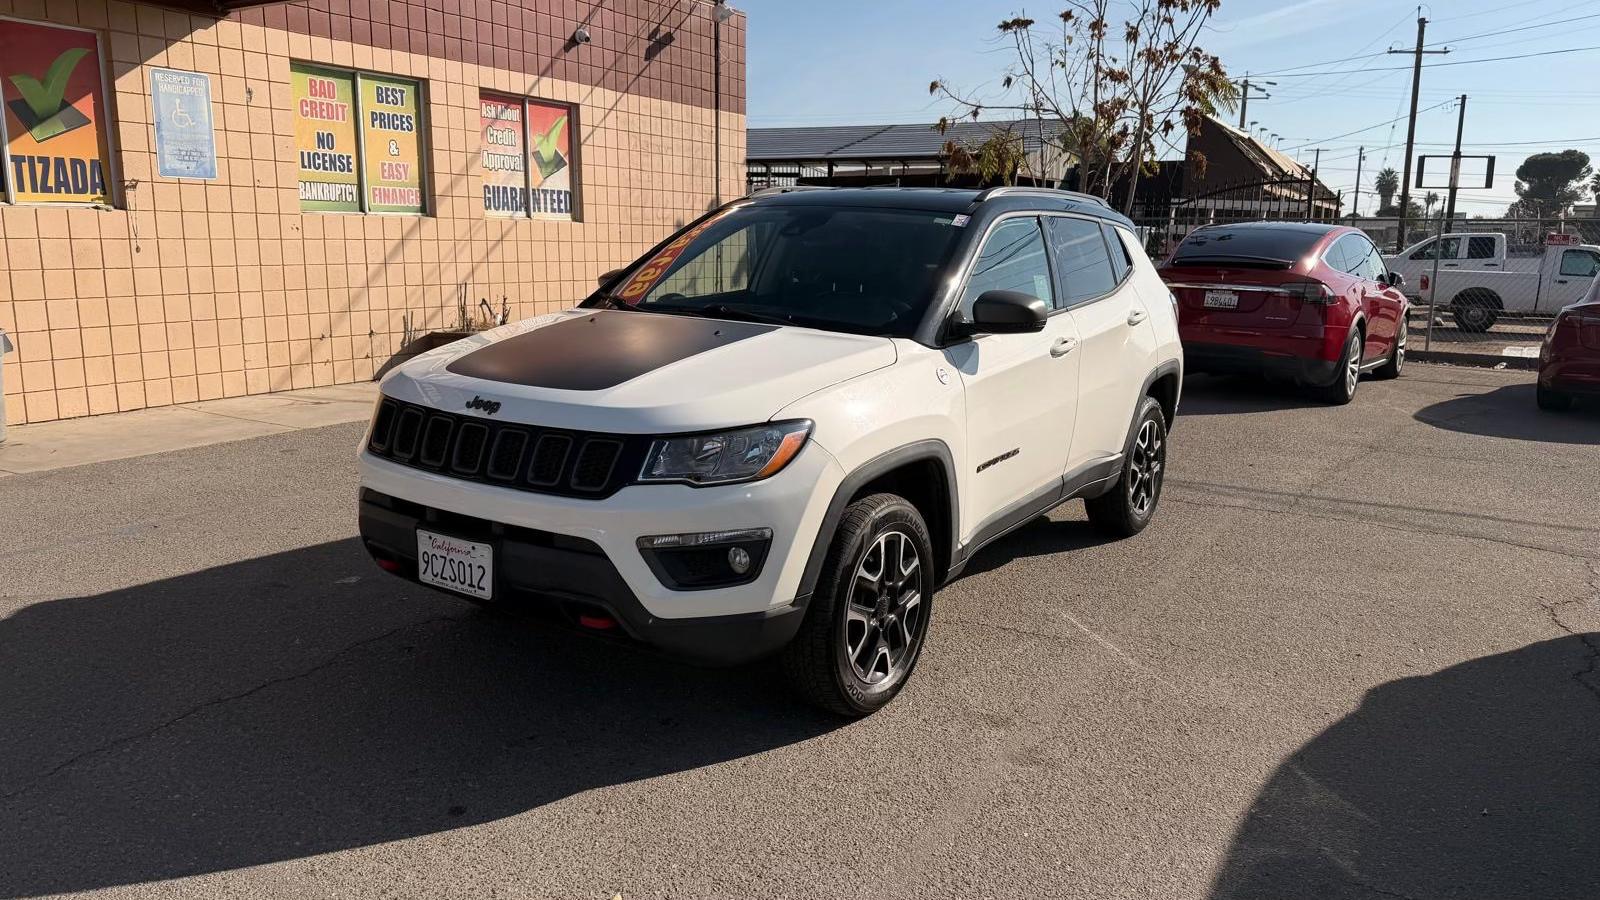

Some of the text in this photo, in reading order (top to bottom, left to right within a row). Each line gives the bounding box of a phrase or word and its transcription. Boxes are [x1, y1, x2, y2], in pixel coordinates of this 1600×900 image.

[154, 72, 206, 88] RESERVED FOR
[159, 83, 206, 96] HANDICAPPED
[308, 78, 336, 99] BAD
[375, 85, 406, 106] BEST
[299, 99, 347, 121] CREDIT
[481, 102, 520, 122] Ask About
[370, 111, 414, 132] PRICES
[316, 131, 335, 151] NO
[486, 125, 517, 147] Credit
[388, 139, 400, 157] &
[300, 151, 353, 173] LICENSE
[380, 161, 410, 181] EASY
[482, 150, 525, 172] Approval
[299, 181, 358, 202] BANKRUPTCY
[371, 186, 421, 206] FINANCE
[483, 184, 572, 213] GUARANTEED
[466, 395, 501, 415] Jeep
[431, 537, 473, 557] California
[421, 550, 487, 592] 9CZS012
